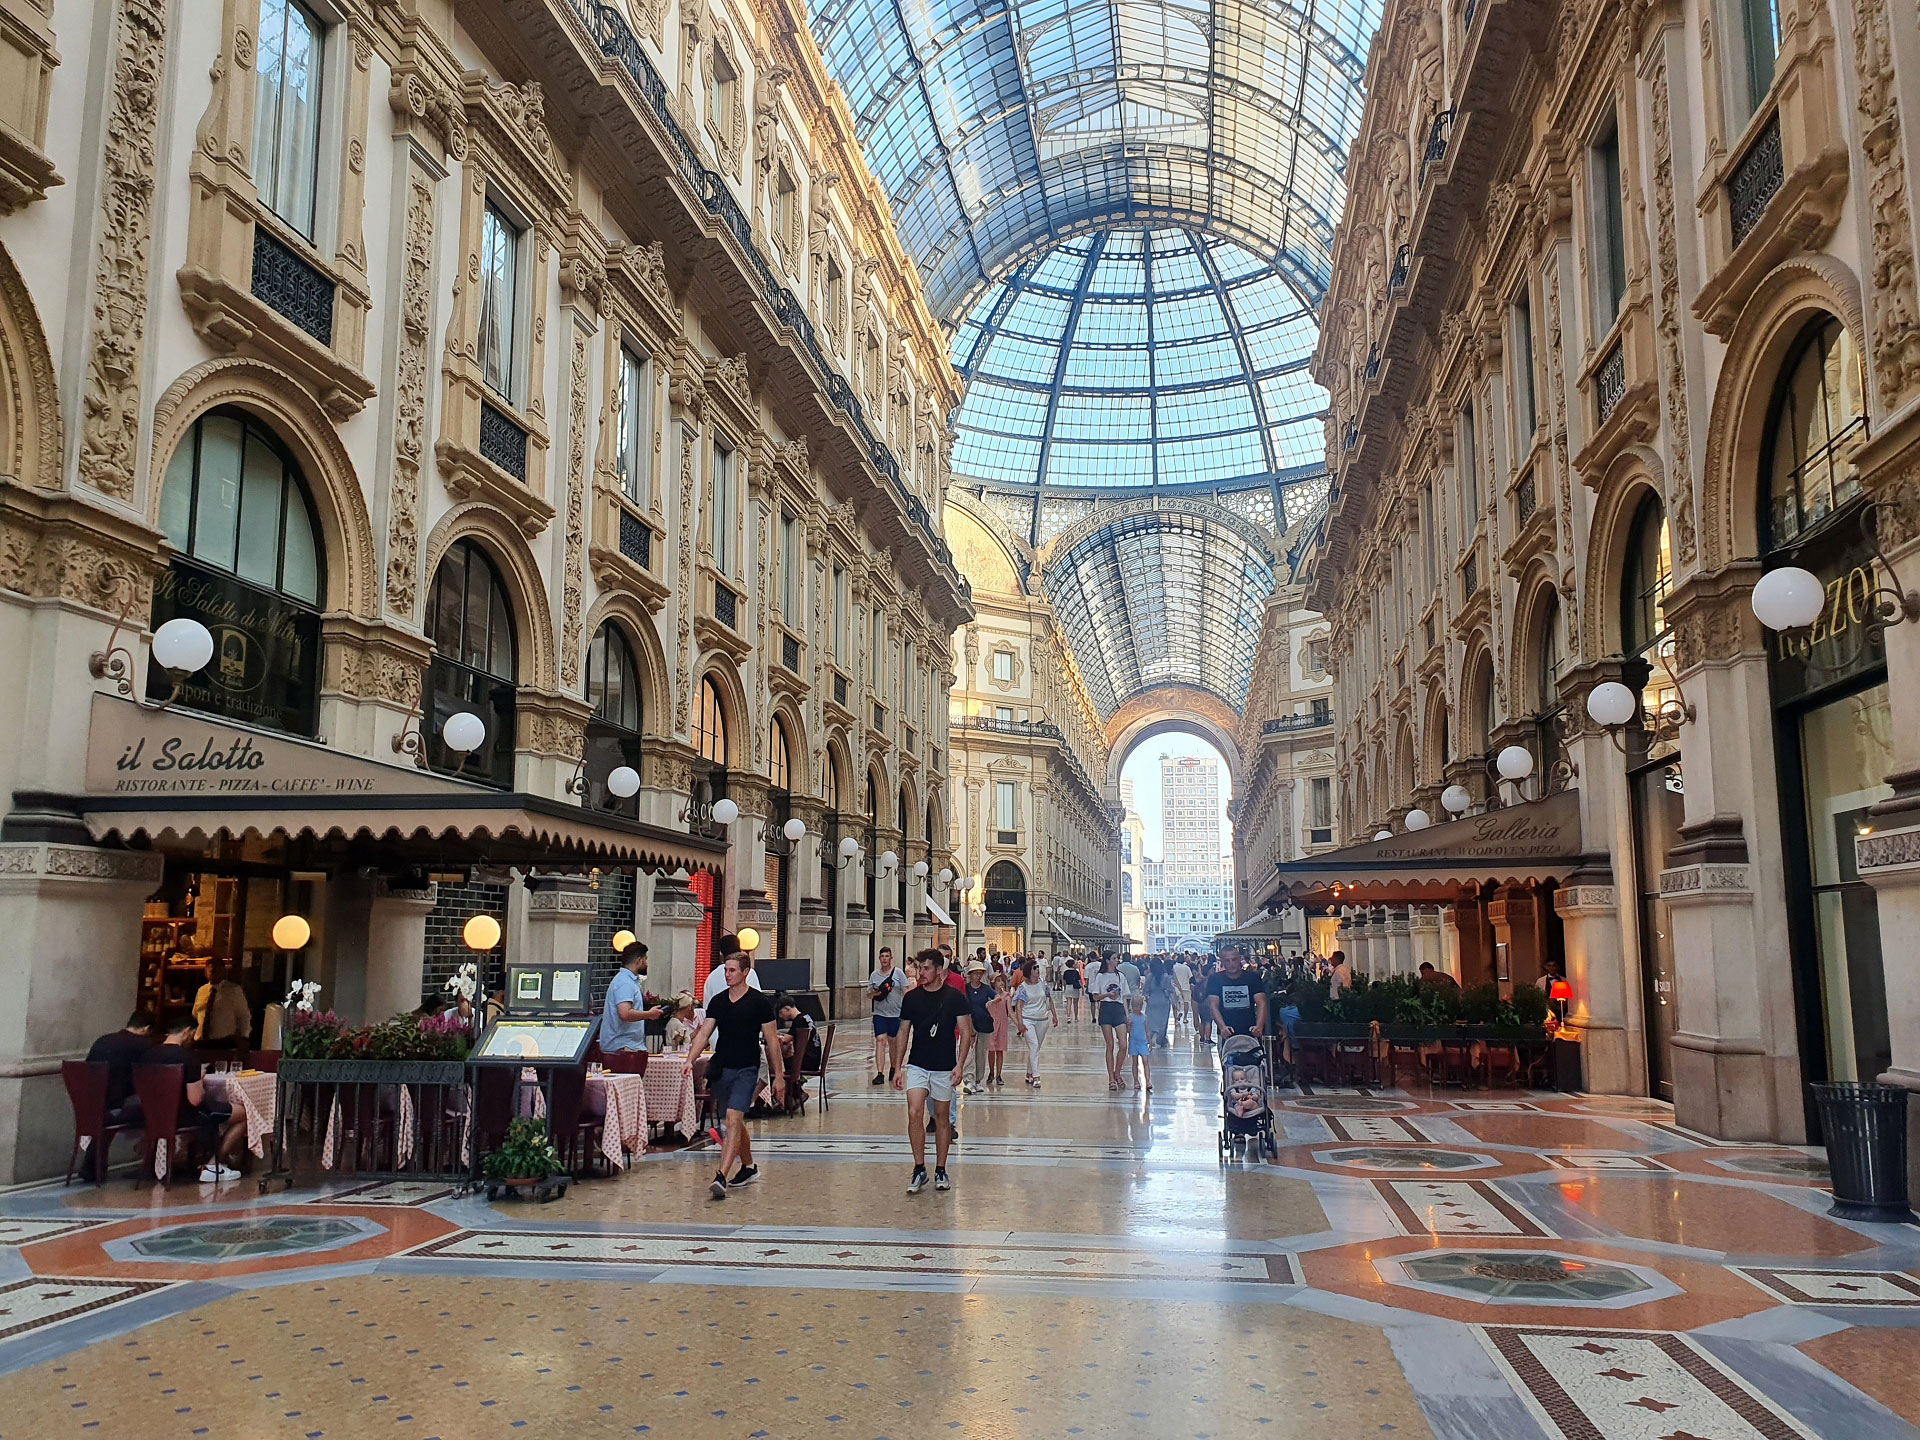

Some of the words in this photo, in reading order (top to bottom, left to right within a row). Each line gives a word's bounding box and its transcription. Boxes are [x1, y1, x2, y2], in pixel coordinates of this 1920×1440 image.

[178, 576, 238, 622] Salotto
[241, 609, 256, 628] di
[214, 694, 222, 705] e
[226, 695, 283, 719] tradizione
[117, 737, 146, 771] il
[153, 736, 264, 771] Salotto
[115, 778, 207, 792] RISTORANTE
[219, 778, 260, 791] PIZZA
[271, 778, 325, 791] CAFFE'
[335, 778, 375, 791] WINE
[1472, 817, 1561, 842] Galleria
[1376, 847, 1449, 858] RESTAURANT
[1458, 847, 1493, 856] WOOD
[1495, 846, 1525, 855] OVEN
[1528, 845, 1561, 855] PIZZA
